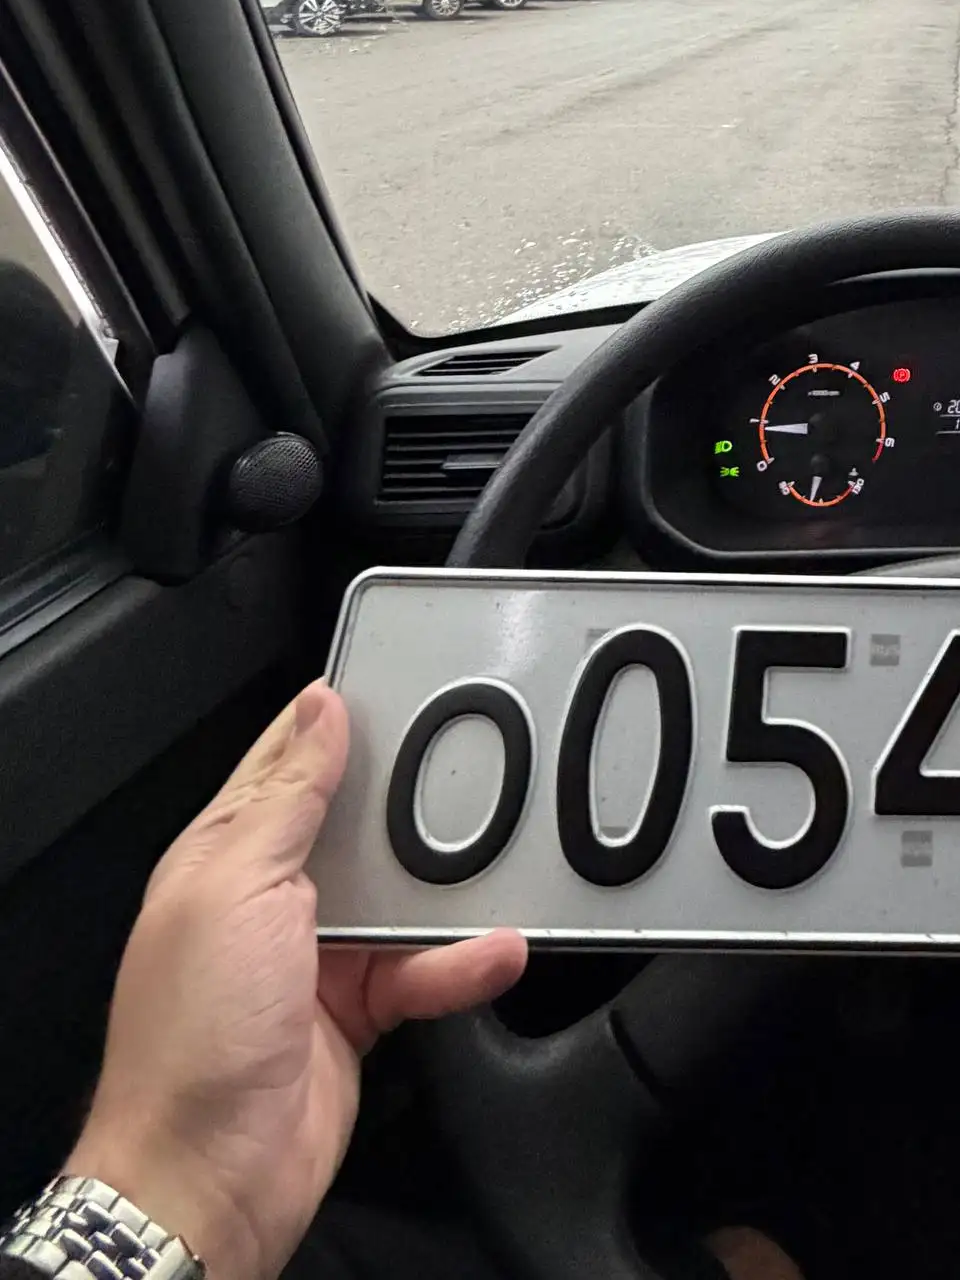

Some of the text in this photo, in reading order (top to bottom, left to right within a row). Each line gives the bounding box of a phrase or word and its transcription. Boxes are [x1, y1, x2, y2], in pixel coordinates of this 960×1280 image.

[808, 353, 818, 363] 3
[850, 361, 861, 370] 4
[768, 374, 781, 386] 2
[879, 391, 891, 403] 5
[884, 437, 895, 448] 6
[756, 463, 768, 472] 0
